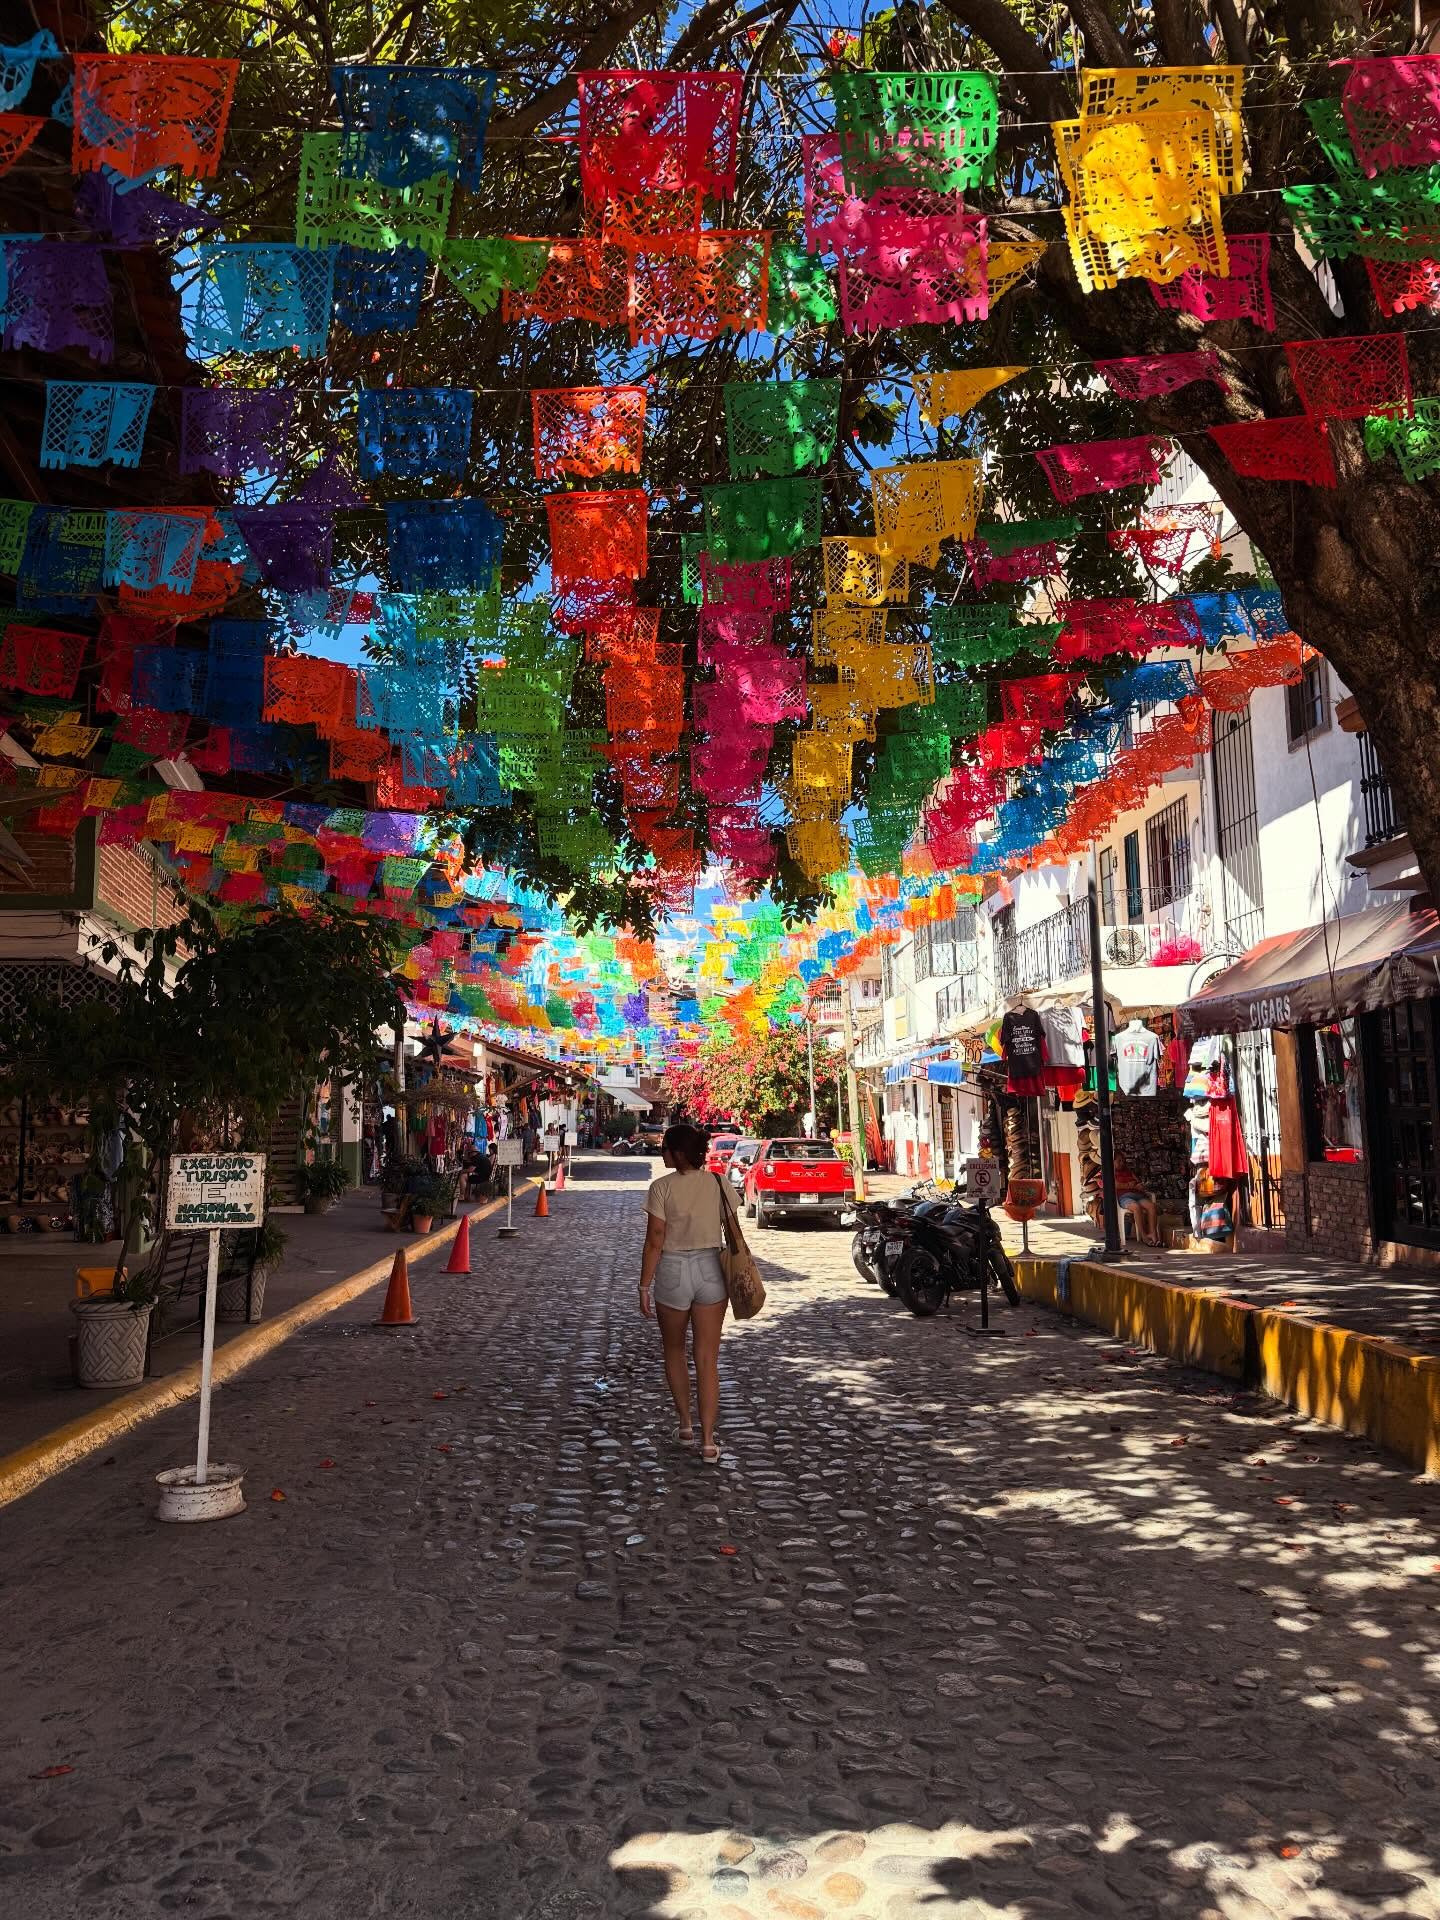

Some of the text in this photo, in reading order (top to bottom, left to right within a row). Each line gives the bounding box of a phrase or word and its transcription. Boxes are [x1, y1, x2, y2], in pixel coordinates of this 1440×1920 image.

[1249, 994, 1291, 1028] CIGARS
[185, 1169, 248, 1182] TURISMO
[201, 1183, 226, 1204] E
[178, 1203, 253, 1213] NACIONAL Y
[175, 1213, 256, 1223] EXTRANJERO
